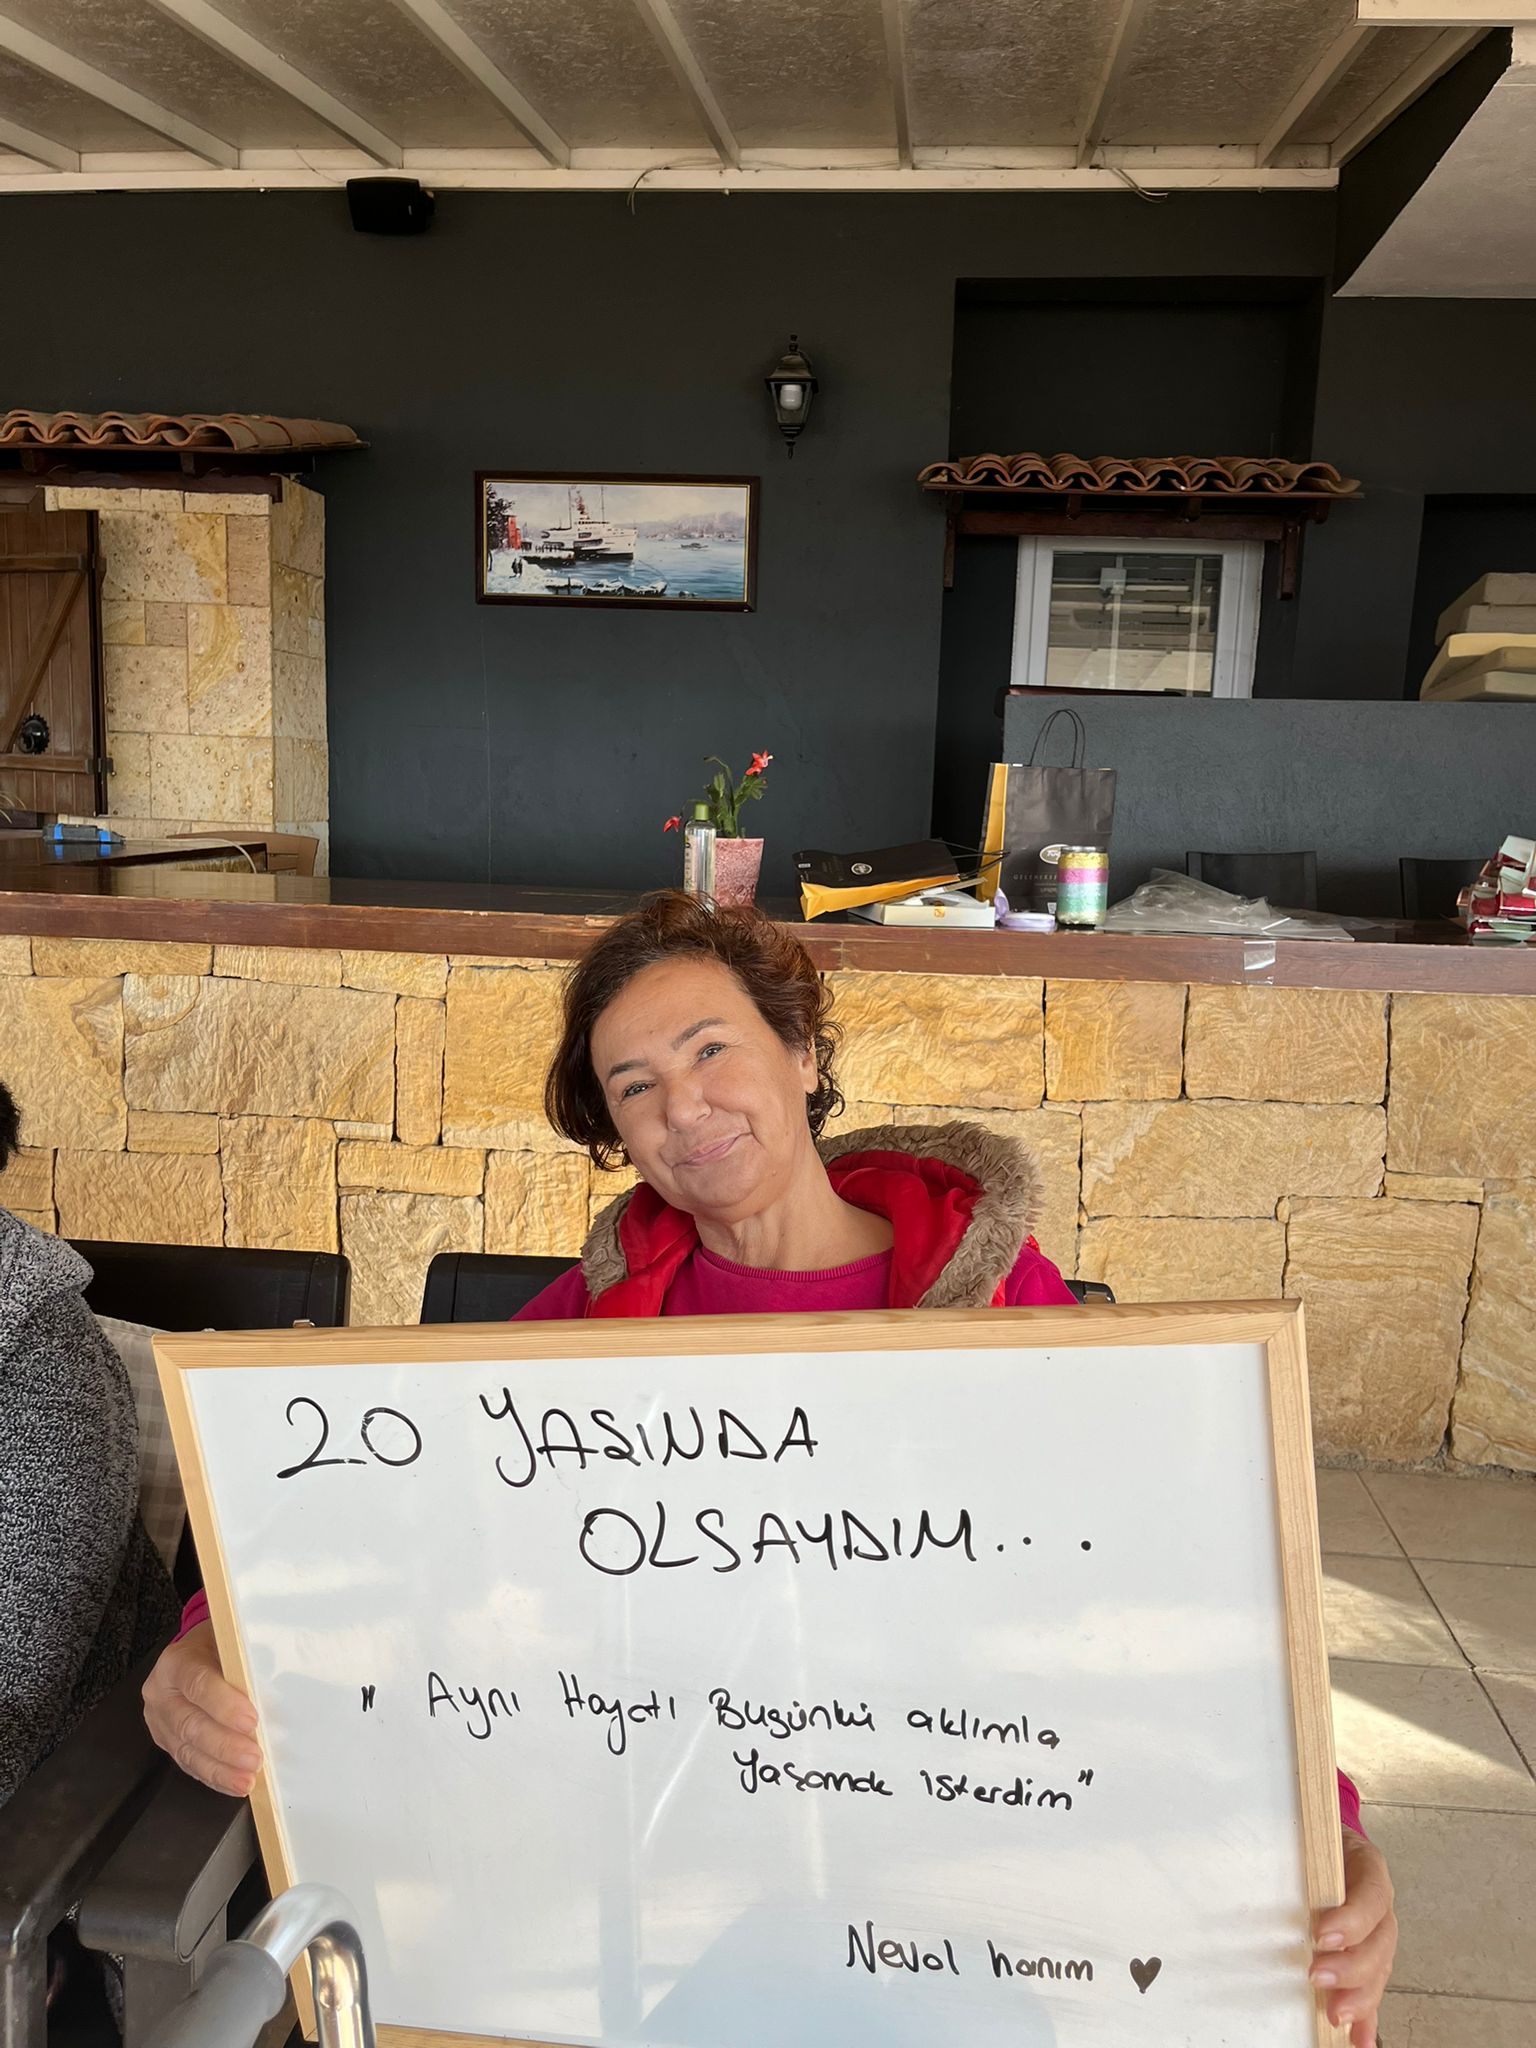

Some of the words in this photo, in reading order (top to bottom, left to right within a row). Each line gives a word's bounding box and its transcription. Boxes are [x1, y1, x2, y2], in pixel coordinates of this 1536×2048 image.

[276, 1397, 422, 1479] 20
[428, 1671, 521, 1740] Aynı
[557, 1670, 677, 1756] Hayatı
[986, 1939, 1093, 1982] hanım
